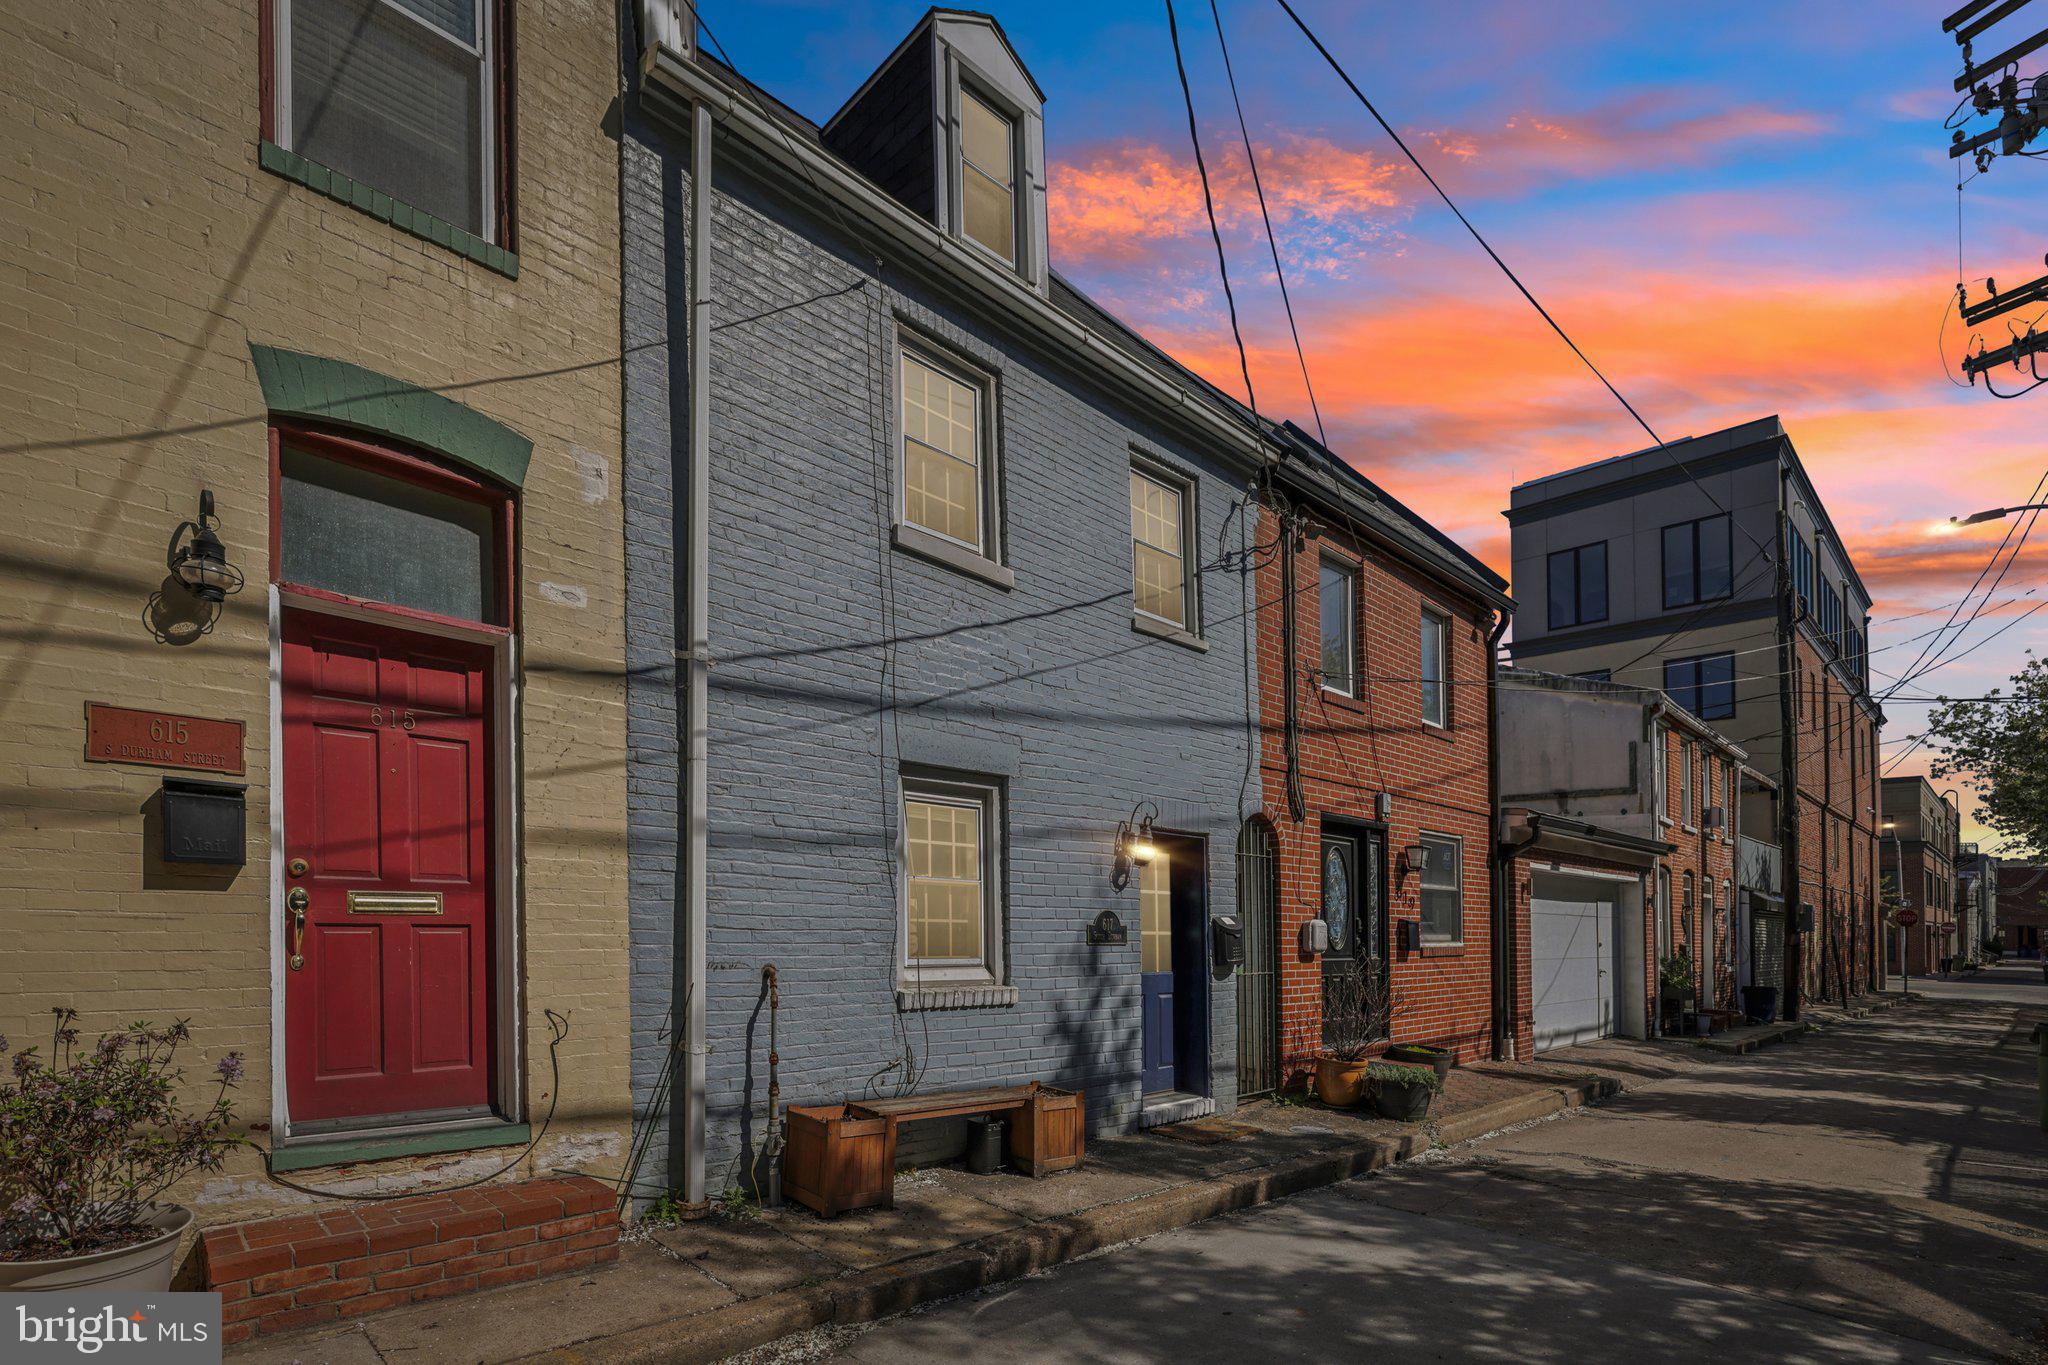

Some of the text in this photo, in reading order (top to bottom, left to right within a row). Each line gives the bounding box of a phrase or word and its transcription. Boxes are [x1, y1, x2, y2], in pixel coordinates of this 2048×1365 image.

[371, 707, 416, 730] 615
[150, 719, 190, 745] 615
[105, 744, 225, 767] S DURHAM STREET
[1102, 918, 1114, 931] 617
[1897, 914, 1917, 923] STOP
